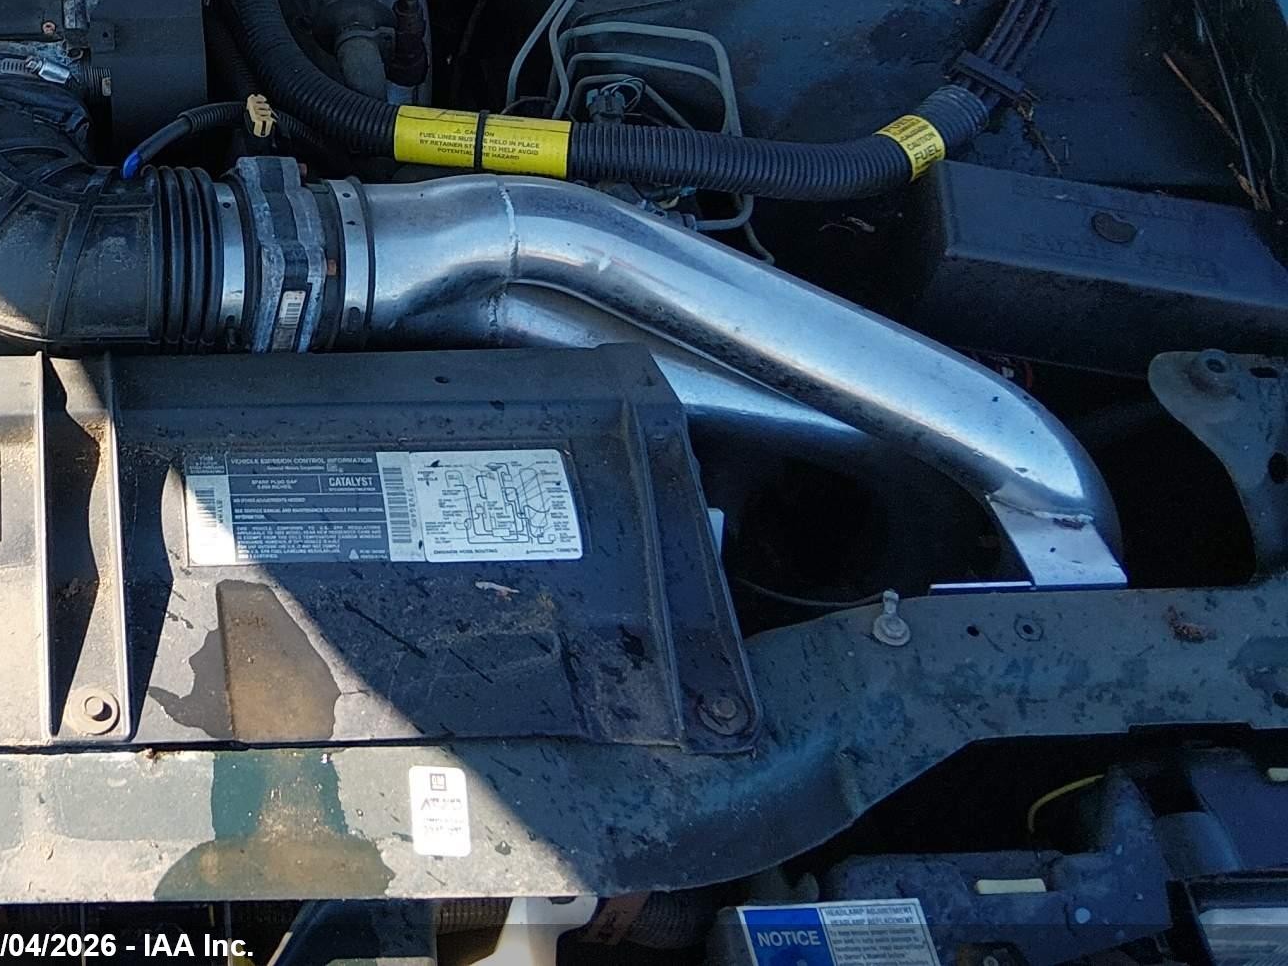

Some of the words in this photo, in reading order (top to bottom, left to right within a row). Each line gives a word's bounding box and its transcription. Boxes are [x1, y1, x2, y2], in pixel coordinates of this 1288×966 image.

[430, 140, 462, 148] RETAINER
[438, 148, 474, 156] POTENTIAL
[328, 476, 373, 487] CATALYST
[825, 907, 864, 916] HEADLAMP
[866, 906, 912, 914] ADJUSTMENT
[756, 930, 822, 947] NOTICE
